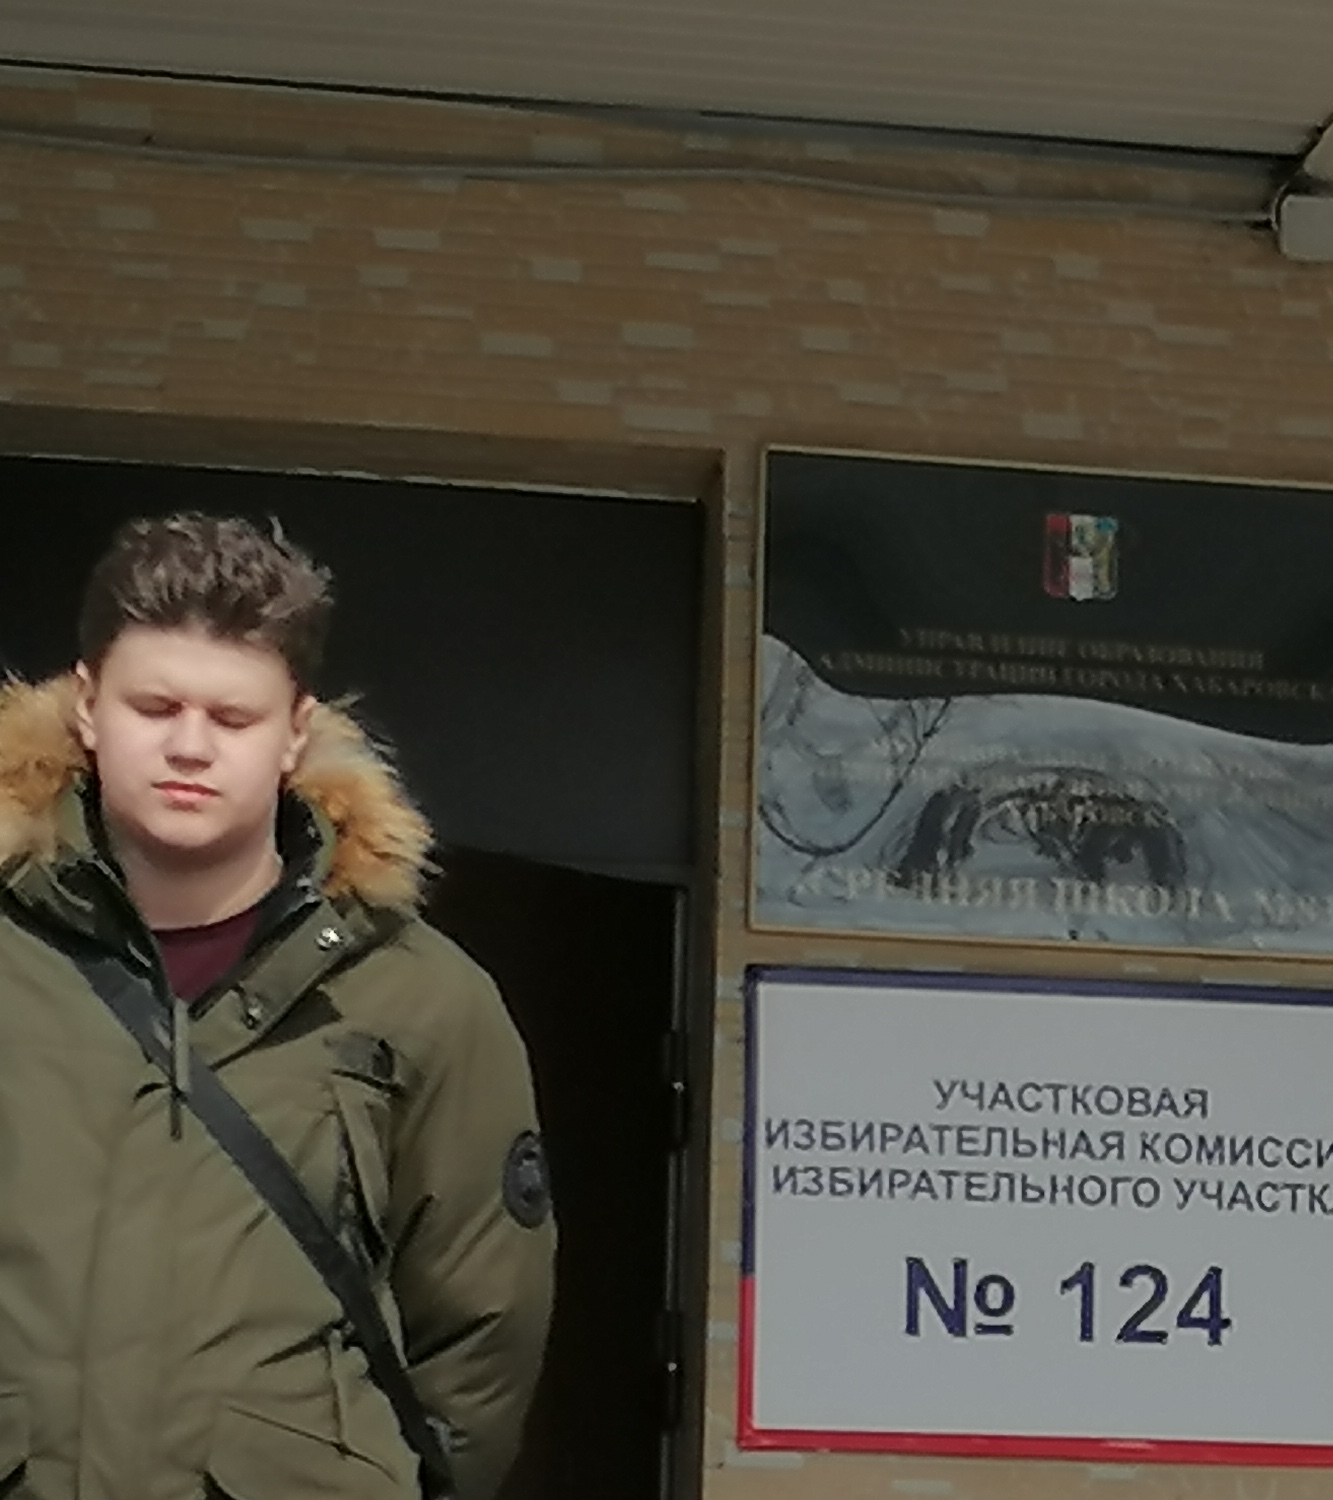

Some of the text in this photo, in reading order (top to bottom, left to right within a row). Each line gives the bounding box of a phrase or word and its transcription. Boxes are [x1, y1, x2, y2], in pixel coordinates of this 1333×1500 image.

[932, 1078, 1209, 1120] УЧАСТКОВАЯ
[764, 1118, 1125, 1162] ИЗБИРАТЕЛЬНАЯ
[771, 1166, 1161, 1209] ИЗБИРАТЕЛЬНОГО
[903, 1257, 1233, 1347] № 124
